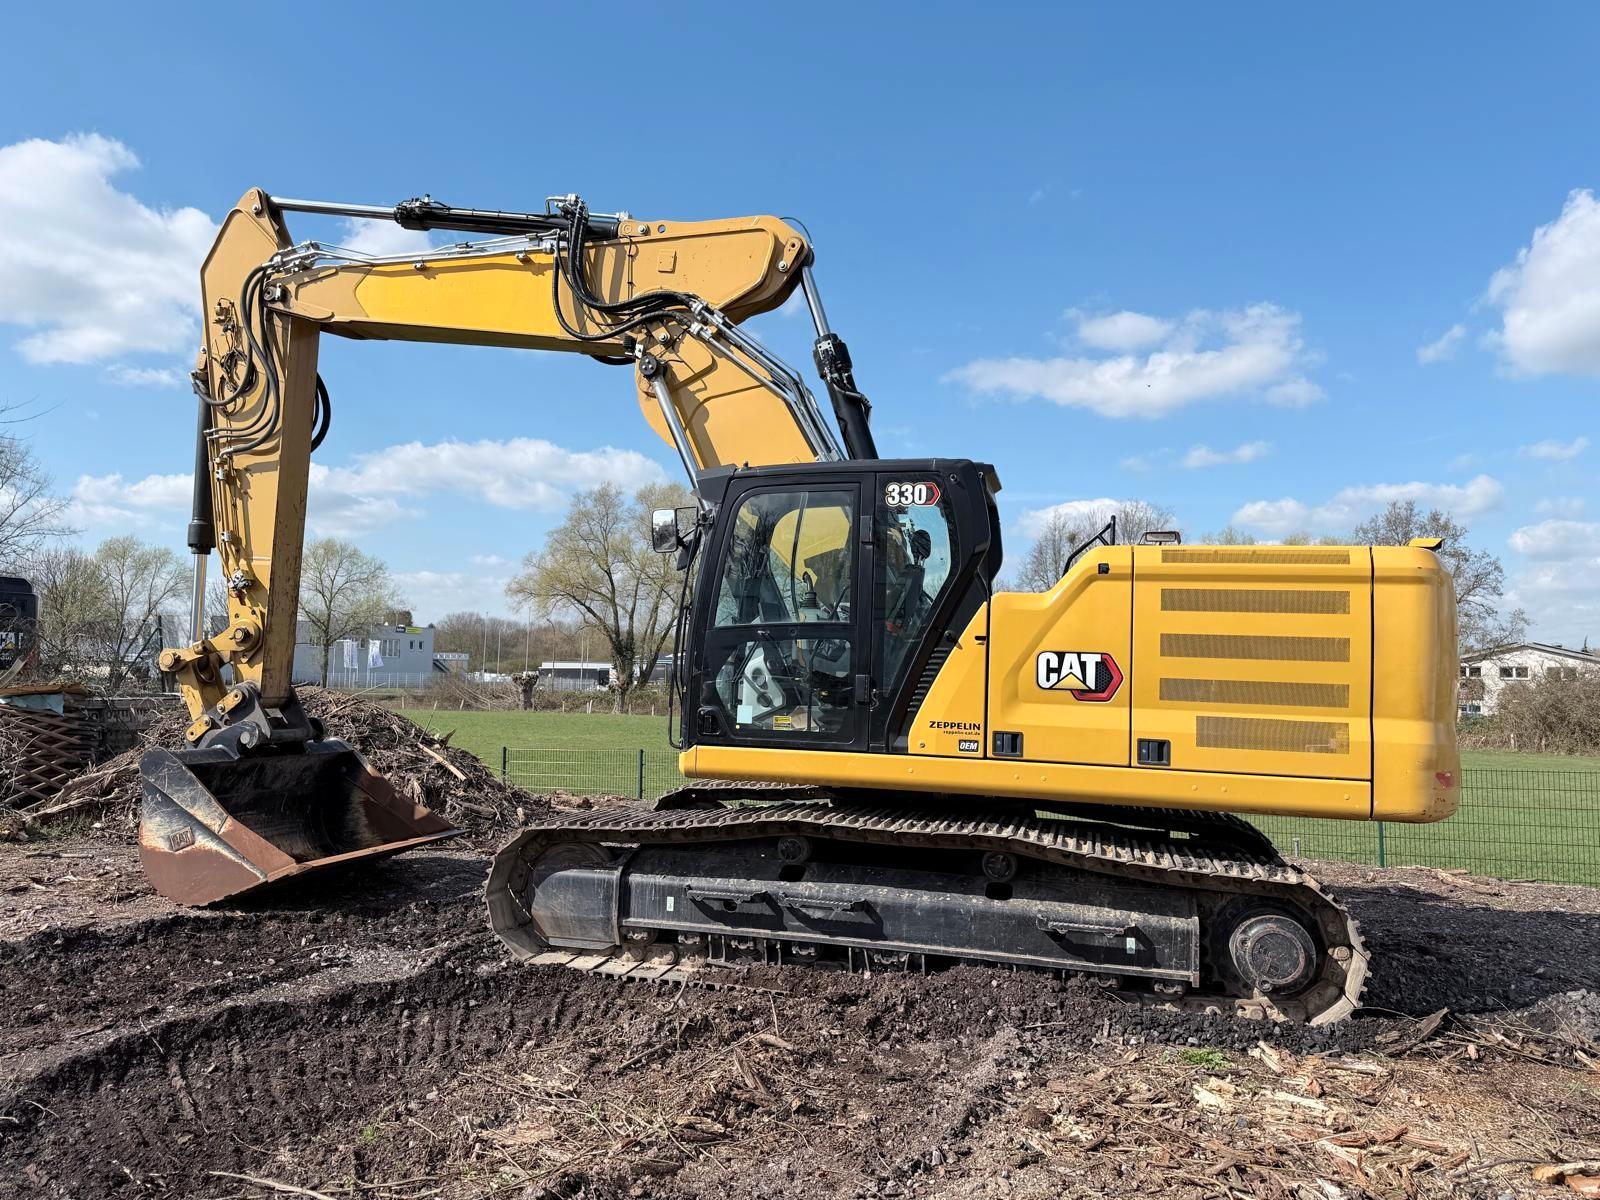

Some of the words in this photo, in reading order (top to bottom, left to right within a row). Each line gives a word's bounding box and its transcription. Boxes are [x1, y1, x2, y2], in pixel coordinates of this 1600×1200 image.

[887, 484, 927, 505] 330
[1037, 651, 1102, 690] CAT
[929, 720, 981, 731] ZEPPELIN
[959, 741, 978, 751] OEM
